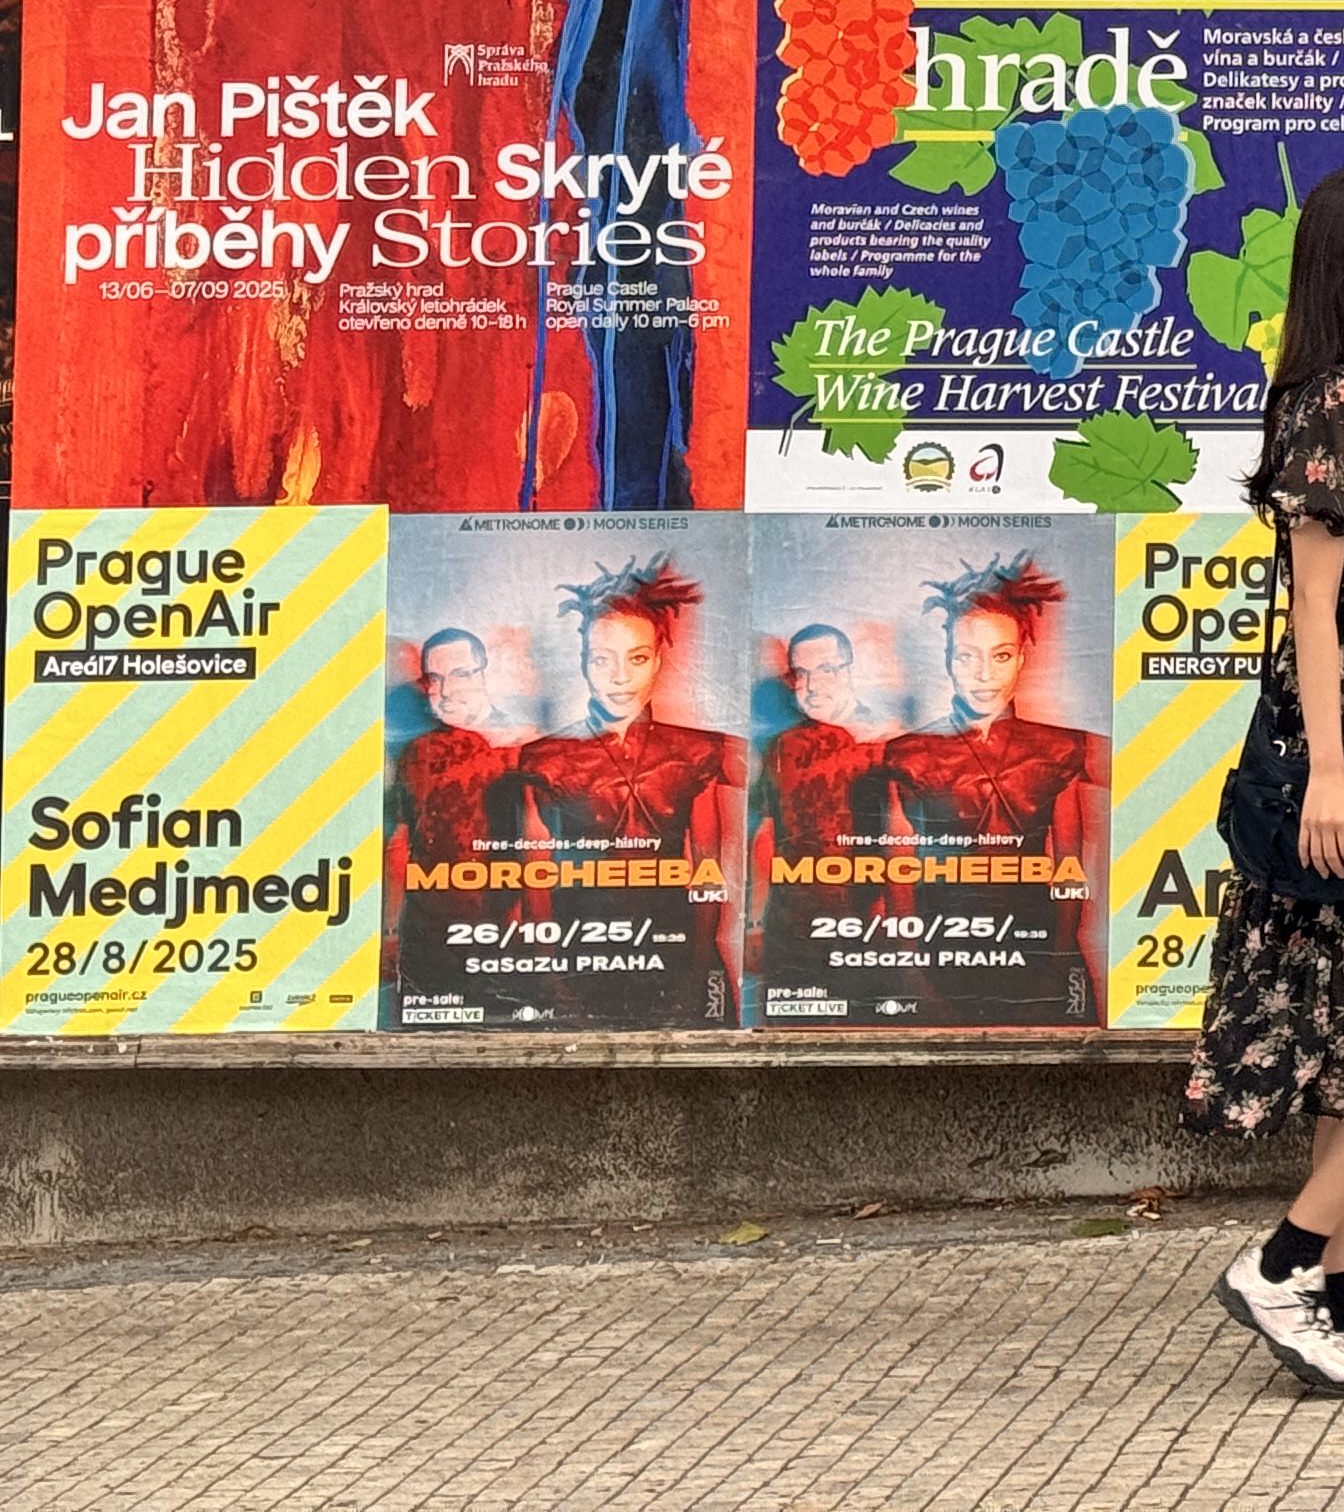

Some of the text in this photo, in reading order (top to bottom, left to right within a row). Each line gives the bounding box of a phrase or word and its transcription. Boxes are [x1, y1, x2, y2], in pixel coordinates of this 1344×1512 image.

[1203, 28, 1293, 45] Moravská
[1298, 33, 1310, 45] a
[912, 25, 1188, 114] hradě
[1203, 71, 1299, 91] Delikatesy
[1304, 75, 1316, 88] a
[62, 75, 438, 138] Jan Pištěk
[1203, 115, 1281, 135] Program
[1285, 119, 1315, 135] pro
[127, 137, 733, 215] Hidden Skryté
[65, 206, 706, 284] příběhy Stories
[233, 281, 284, 299] 2025
[339, 281, 444, 300] Pražský hrad
[546, 280, 658, 299] Prague Castle
[339, 297, 507, 316] Královský letohrádek
[546, 297, 720, 315] Royal Summer Palace
[814, 316, 1194, 367] The Prague Castle
[814, 371, 1270, 413] Wine Harvest Festival
[594, 518, 636, 530] MOON
[638, 517, 689, 530] SERIES
[37, 538, 245, 596] Prague
[34, 588, 280, 650] OpenAir
[43, 653, 247, 677] Areál7 Holešovice
[29, 793, 242, 850] Sofian
[406, 859, 727, 890] MORCHEEBA
[771, 856, 1088, 884] MORCHEEBA
[27, 856, 352, 929] Medjmedj
[688, 889, 728, 903] (UK)
[1050, 886, 1091, 901] (UK)
[27, 939, 258, 975] 28/8/2025
[465, 954, 665, 973] SaSaZu PRAHA
[829, 950, 1027, 969] SaSaZu PRAHA
